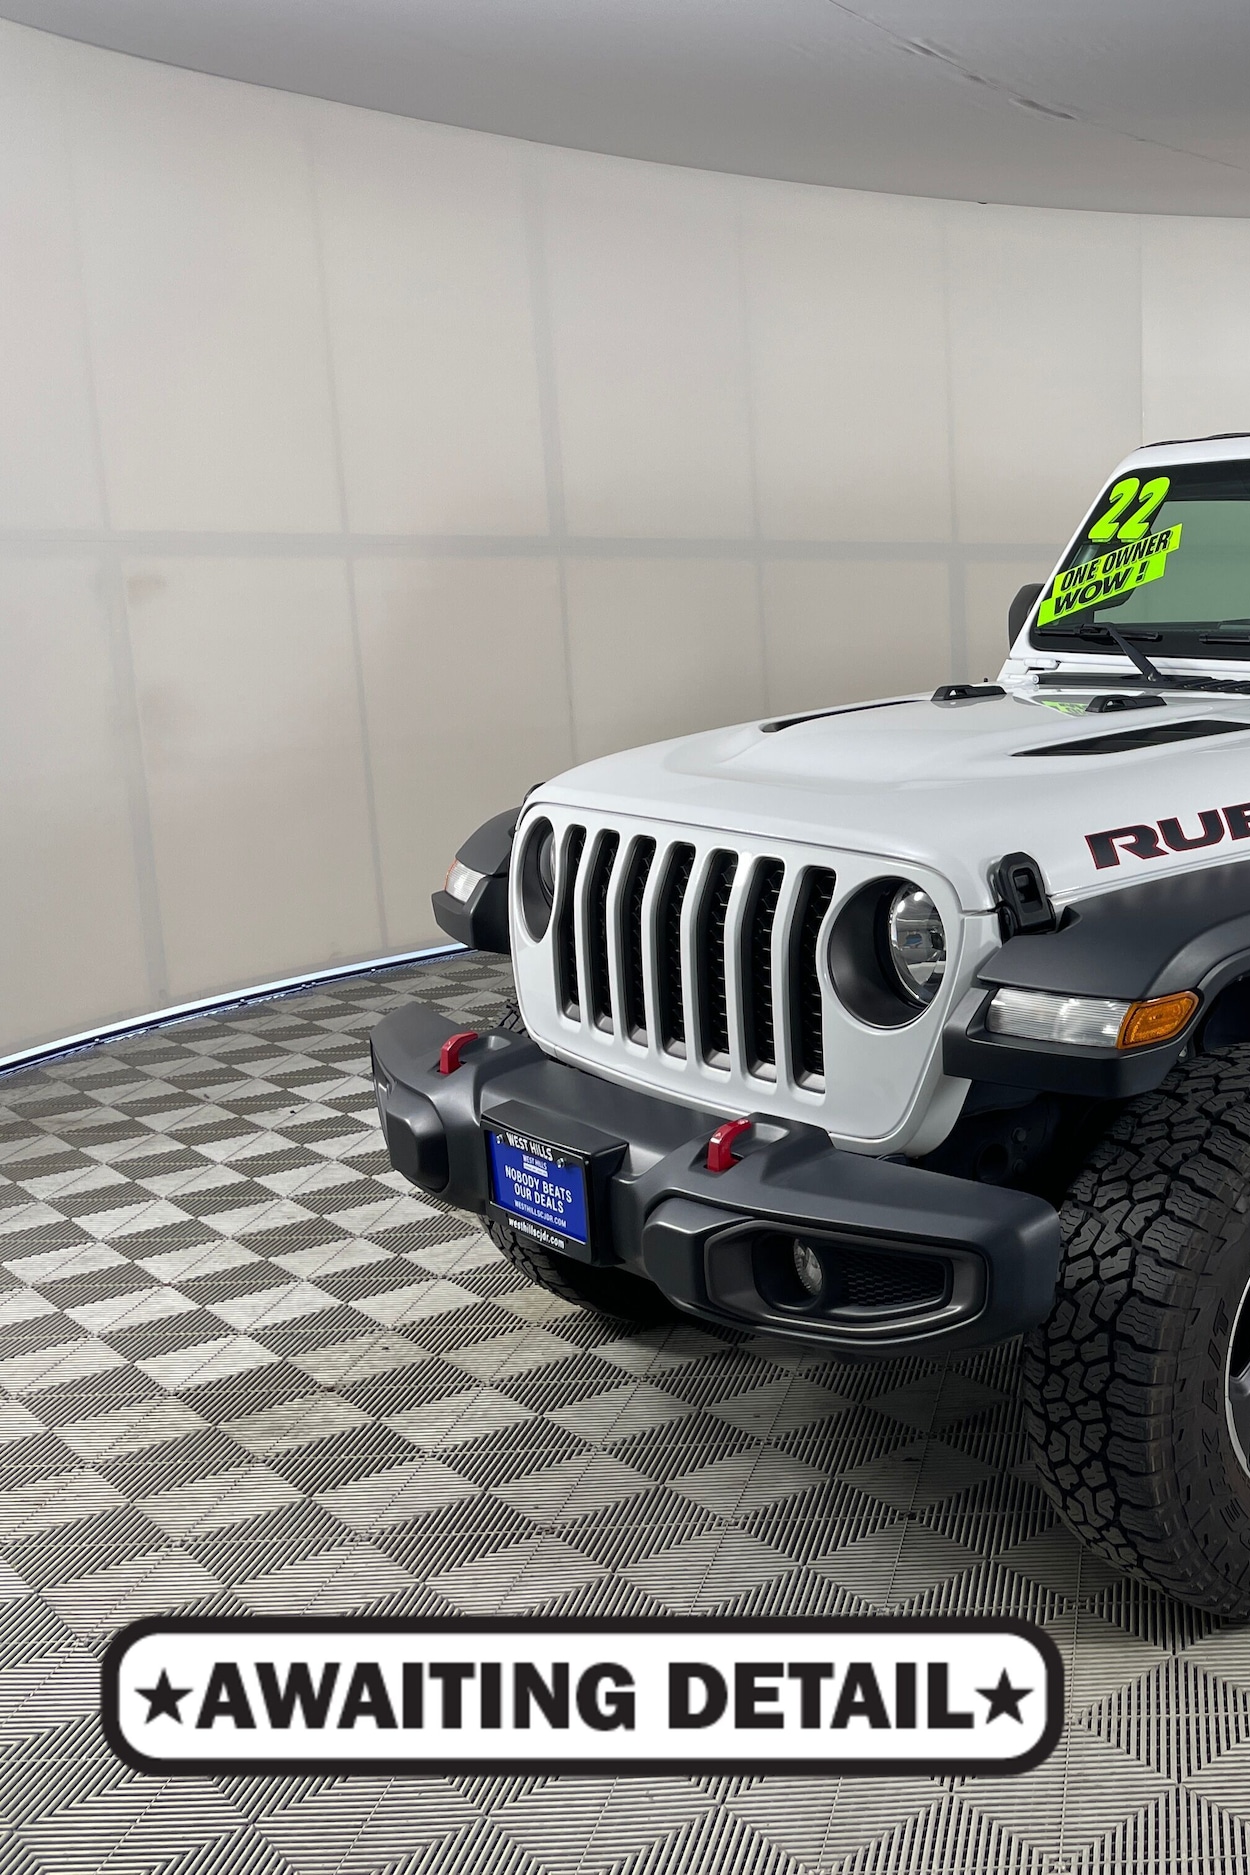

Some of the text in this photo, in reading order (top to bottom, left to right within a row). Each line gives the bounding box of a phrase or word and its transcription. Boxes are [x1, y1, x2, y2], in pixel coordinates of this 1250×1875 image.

[1088, 476, 1171, 543] 22
[1060, 529, 1174, 592] ONE OWNER
[1053, 566, 1135, 616] WOW
[506, 1132, 554, 1162] WEST HILLS
[522, 1154, 535, 1164] WEST
[504, 1165, 540, 1191] NOBODY
[542, 1180, 573, 1204] BEATS
[514, 1183, 564, 1214] OUR DEALS
[514, 1199, 567, 1229] WESTHILLSCJDR.COM
[508, 1218, 565, 1250] westhillscjdr.com
